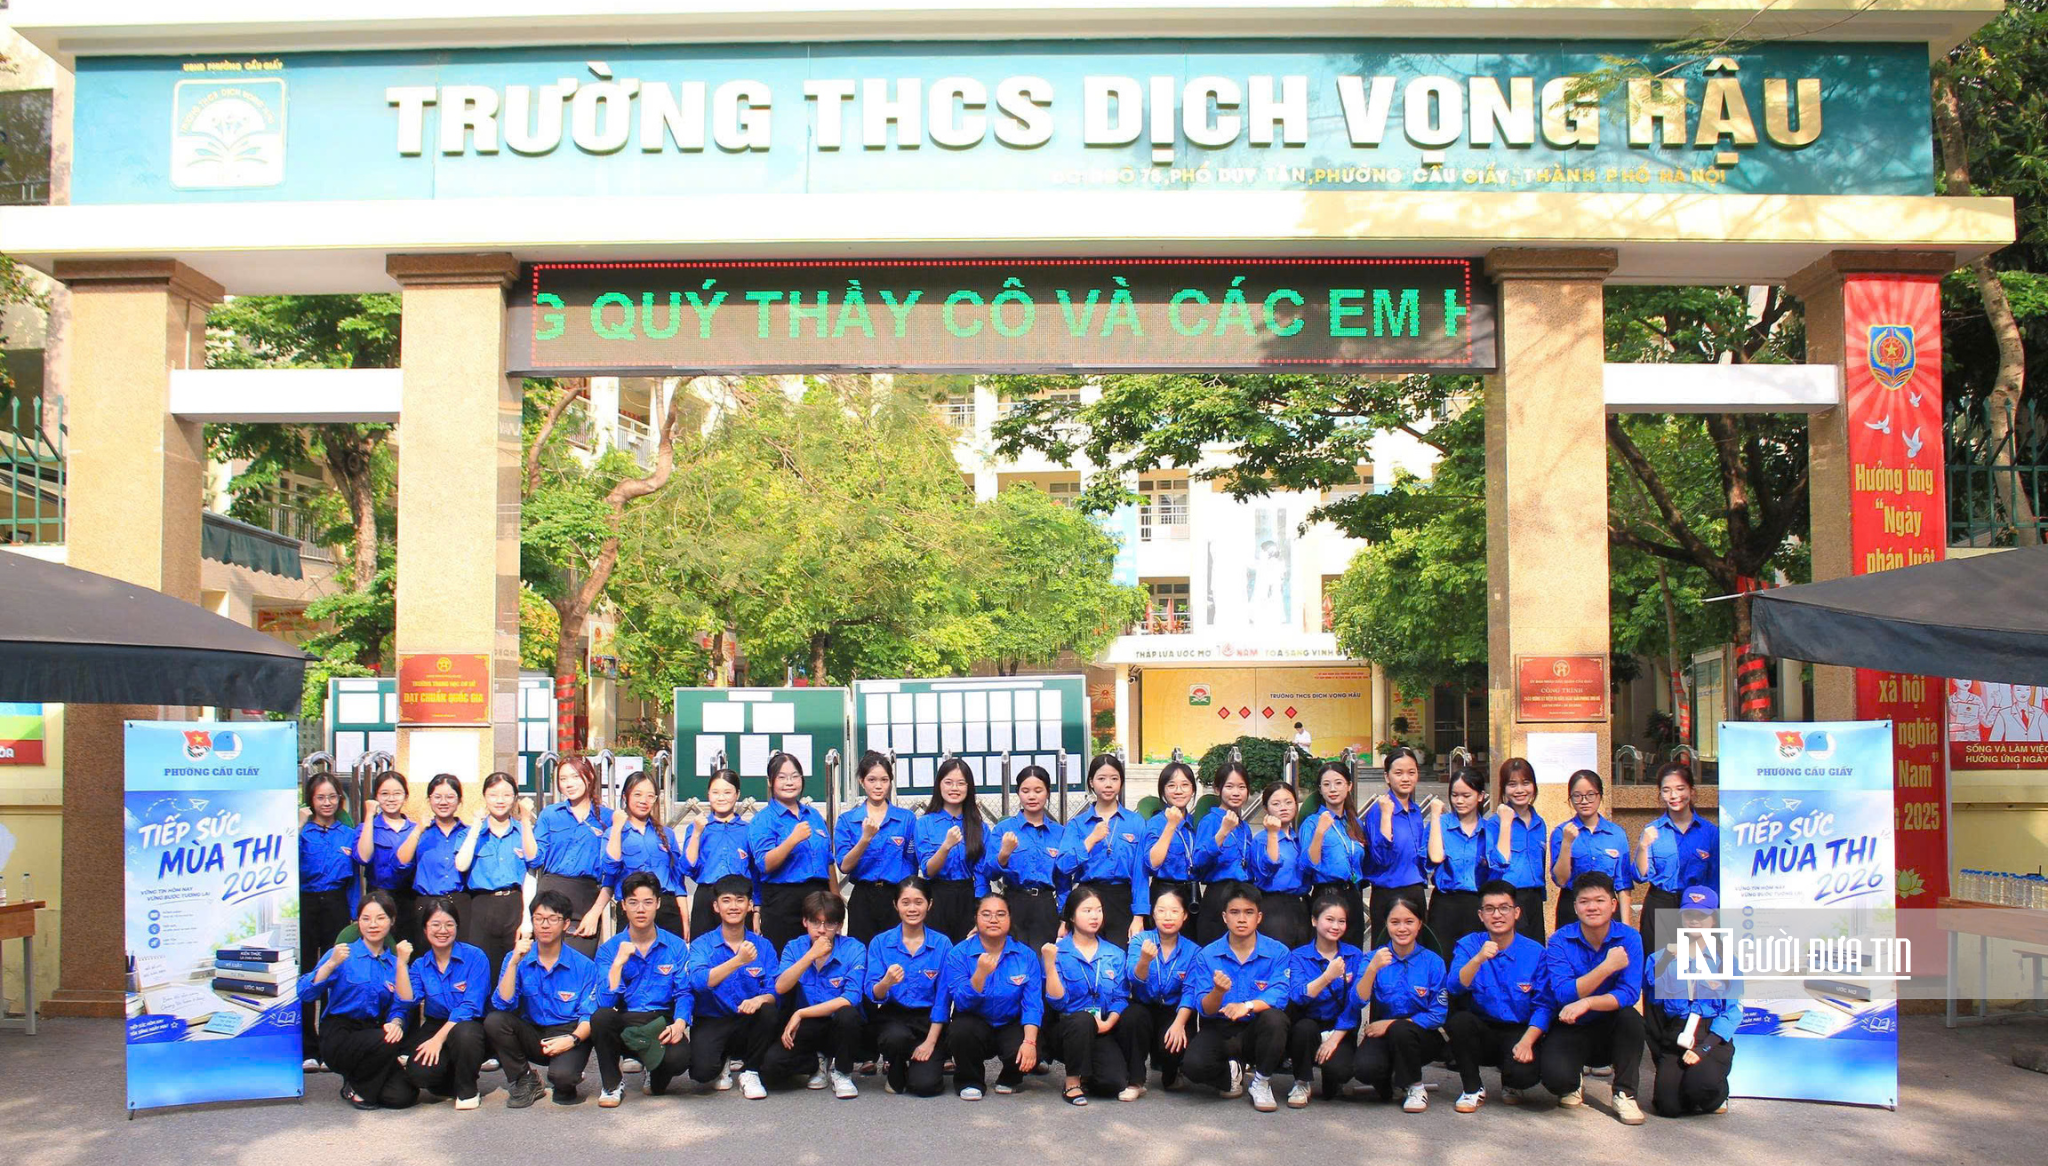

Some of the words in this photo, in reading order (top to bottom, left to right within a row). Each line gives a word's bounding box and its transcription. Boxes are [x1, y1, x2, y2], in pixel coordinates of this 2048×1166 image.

[387, 62, 772, 157] TRƯỜNG
[804, 76, 1054, 152] THCS
[1083, 75, 1308, 166] DỊCH
[1336, 75, 1602, 166] VỌNG
[1627, 57, 1823, 170] HẬU
[1217, 168, 1257, 183] DUY
[1412, 162, 1456, 183] CẦU
[1523, 162, 1597, 183] THÀNH
[1605, 161, 1650, 183] PHỐ
[1659, 162, 1685, 183] HÀ
[590, 278, 728, 341] QUÝ
[745, 278, 924, 339] THẦY
[942, 277, 1036, 338] CÔ
[1056, 276, 1145, 337] VÀ
[1168, 276, 1305, 337] CÁC
[1329, 289, 1420, 337] EM
[1855, 460, 1903, 494] Hưởng
[1907, 465, 1934, 495] ứng
[1878, 675, 1898, 703] xã
[1902, 675, 1926, 709] hội
[1898, 717, 1938, 748] nghĩa
[1966, 743, 1992, 753] SỐNG
[1995, 744, 2006, 753] VÀ
[2009, 744, 2028, 753] LÀM
[164, 766, 210, 777] PHƯỜNG
[235, 766, 260, 776] GIẤY
[1966, 753, 1998, 763] HƯỞNG
[2001, 753, 2020, 763] ỨNG
[2022, 754, 2048, 763] NGÀY
[138, 813, 191, 849] TIẾP
[195, 809, 242, 841] SỨC
[1733, 812, 1783, 847] TIẾP
[1789, 809, 1835, 841] SỨC
[1904, 802, 1940, 831] 2025
[158, 840, 225, 880] MÙA
[233, 834, 283, 869] THI
[1751, 839, 1818, 878] MÙA
[1826, 836, 1877, 869] THI
[222, 860, 288, 901] 2026
[1814, 862, 1884, 902] 2026
